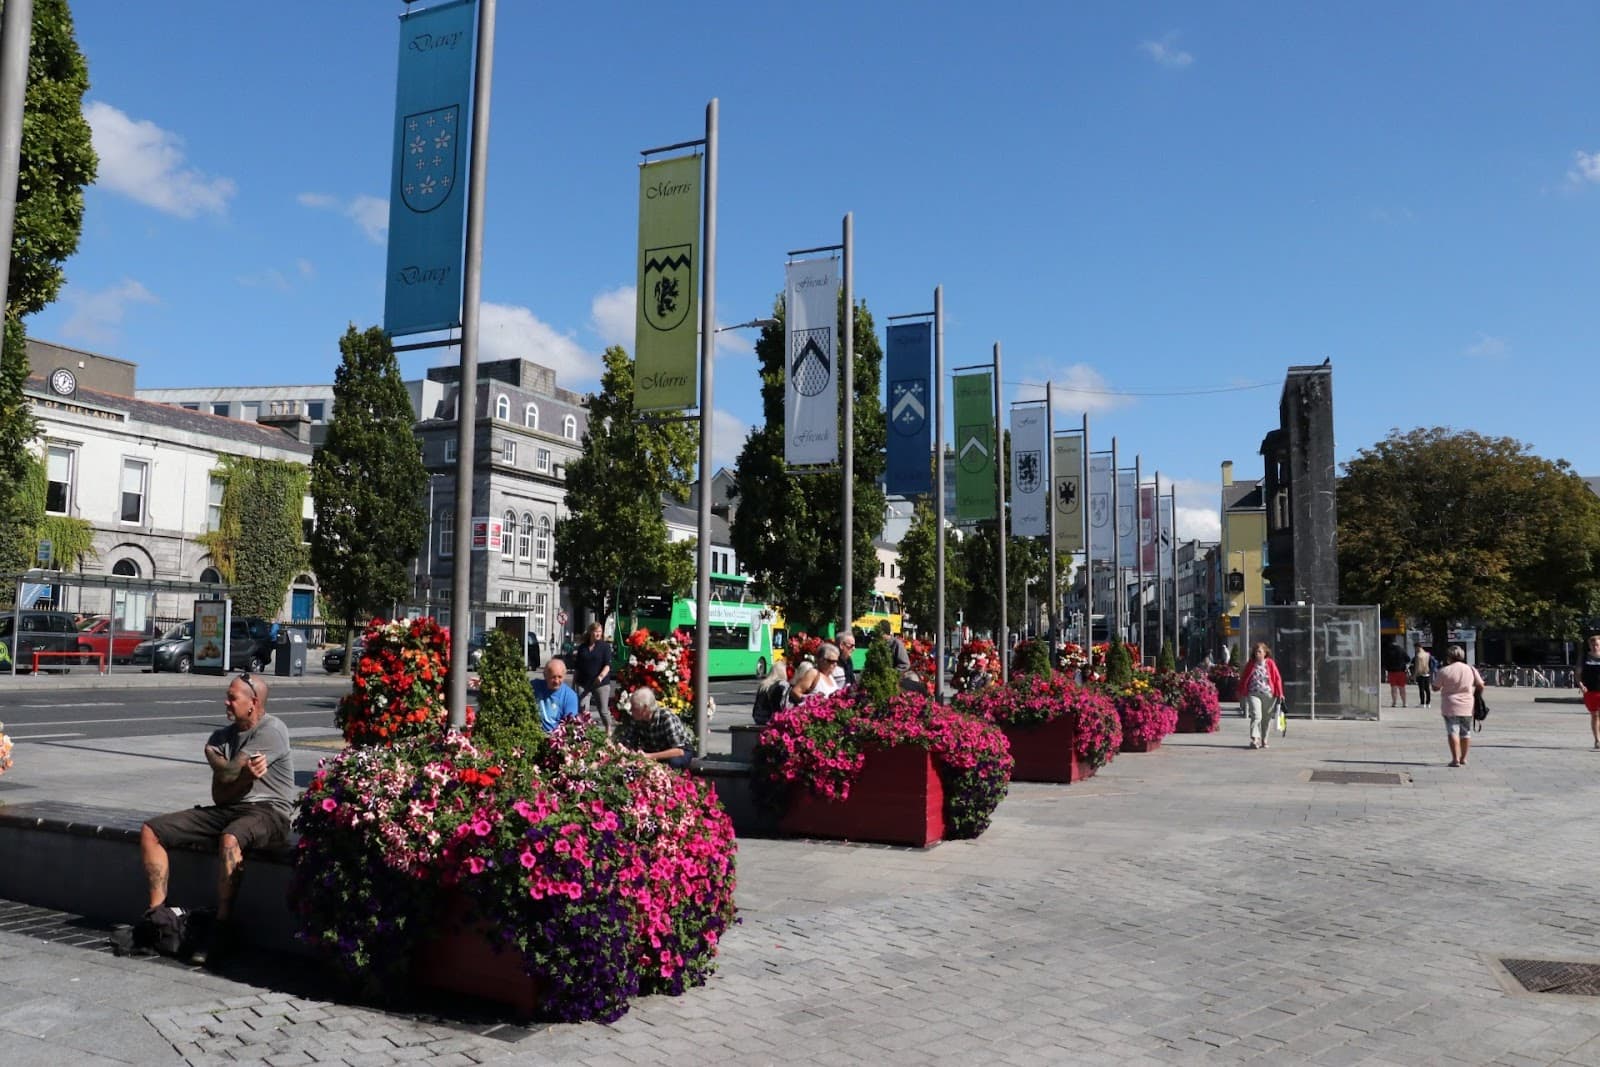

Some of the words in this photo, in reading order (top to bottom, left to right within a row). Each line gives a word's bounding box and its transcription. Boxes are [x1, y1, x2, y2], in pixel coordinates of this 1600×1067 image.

[646, 180, 692, 199] Morris
[640, 371, 688, 390] Morris
[65, 404, 117, 420] IRELAND
